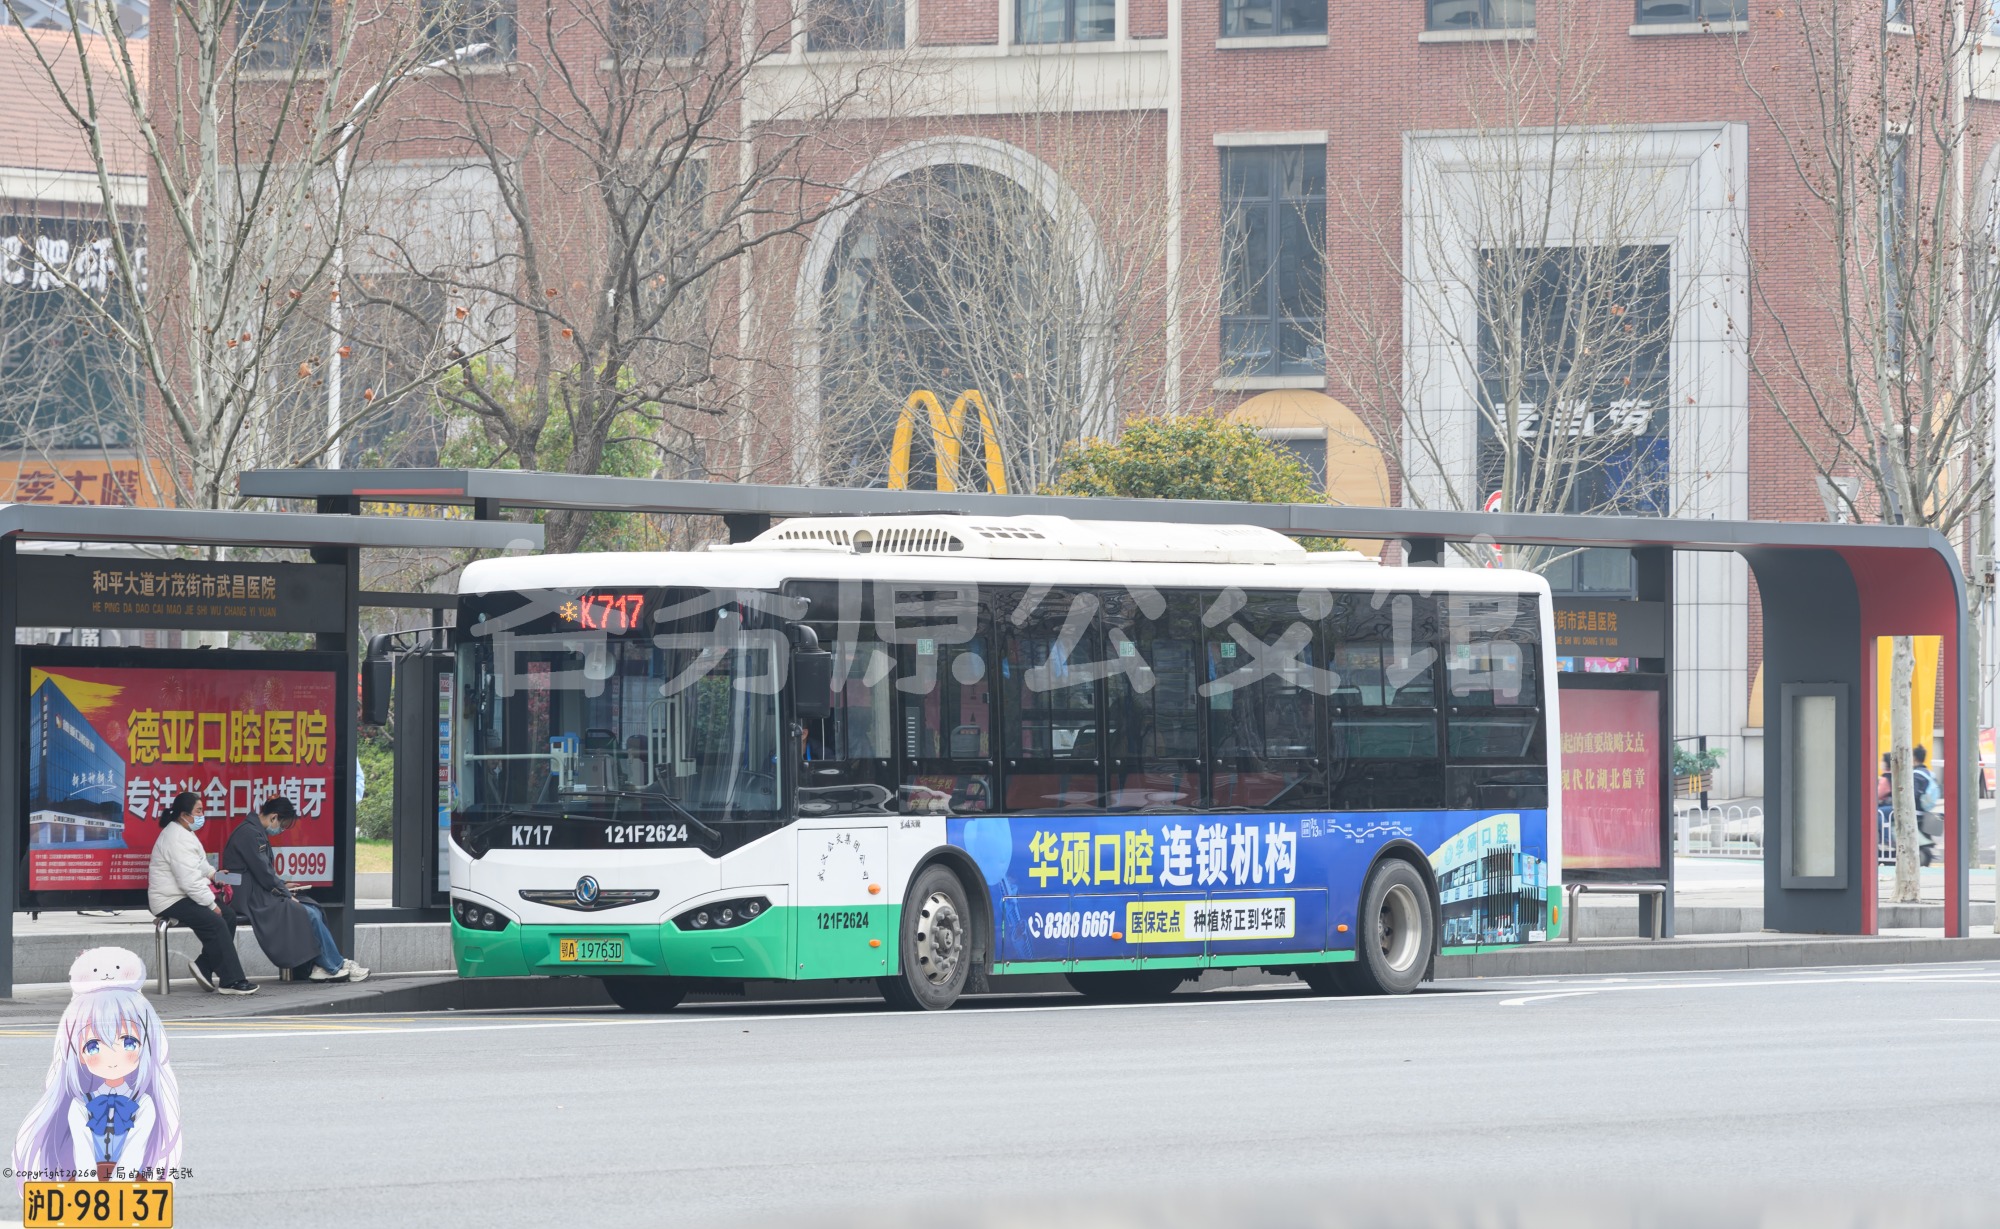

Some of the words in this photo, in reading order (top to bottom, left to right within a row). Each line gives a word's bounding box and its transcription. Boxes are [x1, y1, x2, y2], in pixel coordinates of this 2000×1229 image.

[93, 569, 276, 600] 和平大道才茂街市武昌医院
[93, 602, 101, 612] HE
[104, 603, 120, 613] PING
[123, 603, 132, 613] DA
[135, 604, 149, 613] DAO
[152, 604, 163, 614] CAI
[167, 604, 181, 614] MAO
[185, 605, 194, 615] JIE
[197, 605, 208, 615] SHI
[211, 605, 221, 616] WU
[224, 606, 246, 616] CHANG
[250, 606, 256, 616] YI
[259, 607, 276, 617] YUAN
[581, 595, 644, 629] K717
[1554, 610, 1617, 631] 街市武昌医院
[128, 707, 327, 765] 德亚口腔医院
[1561, 731, 1645, 753] 起的重要战略支点
[511, 825, 553, 846] K717
[605, 824, 688, 844] 121F2624
[288, 852, 326, 875] 9999
[1028, 829, 1154, 888] 华硕口腔
[1160, 822, 1297, 887] 连锁机构
[816, 911, 869, 930] 121F2624
[1044, 913, 1079, 939] 8388
[1081, 911, 1116, 937] 6661
[1131, 910, 1181, 935] 医保定点
[1193, 907, 1287, 932] 种植矫正到华硕
[581, 942, 622, 958] 19763D
